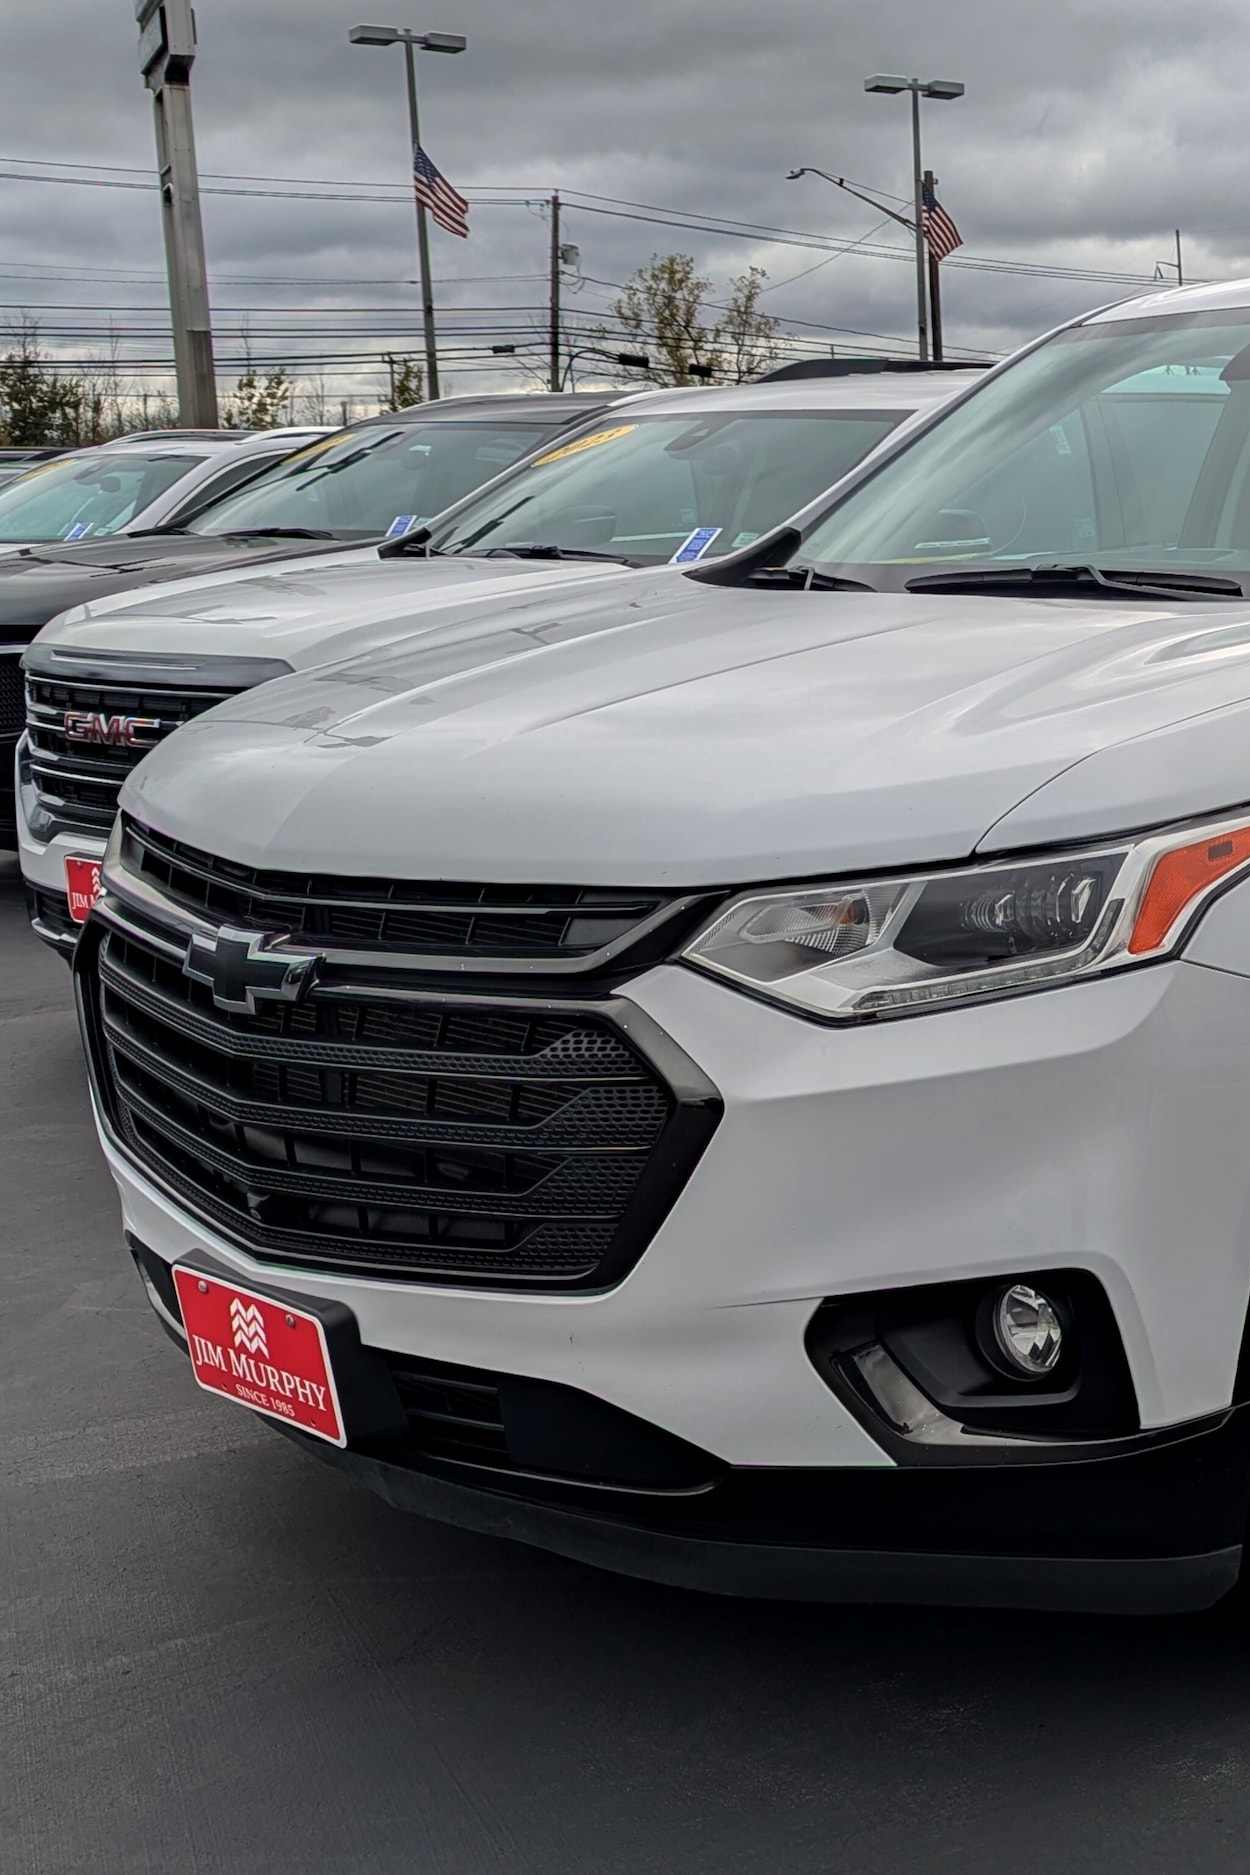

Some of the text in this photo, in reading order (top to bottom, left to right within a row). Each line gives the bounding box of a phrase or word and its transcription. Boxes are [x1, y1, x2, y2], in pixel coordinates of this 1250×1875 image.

[64, 711, 160, 748] GMC
[71, 891, 90, 910] JIM
[192, 1334, 327, 1412] JIM MURPHY
[235, 1384, 296, 1418] SINCE 1985
